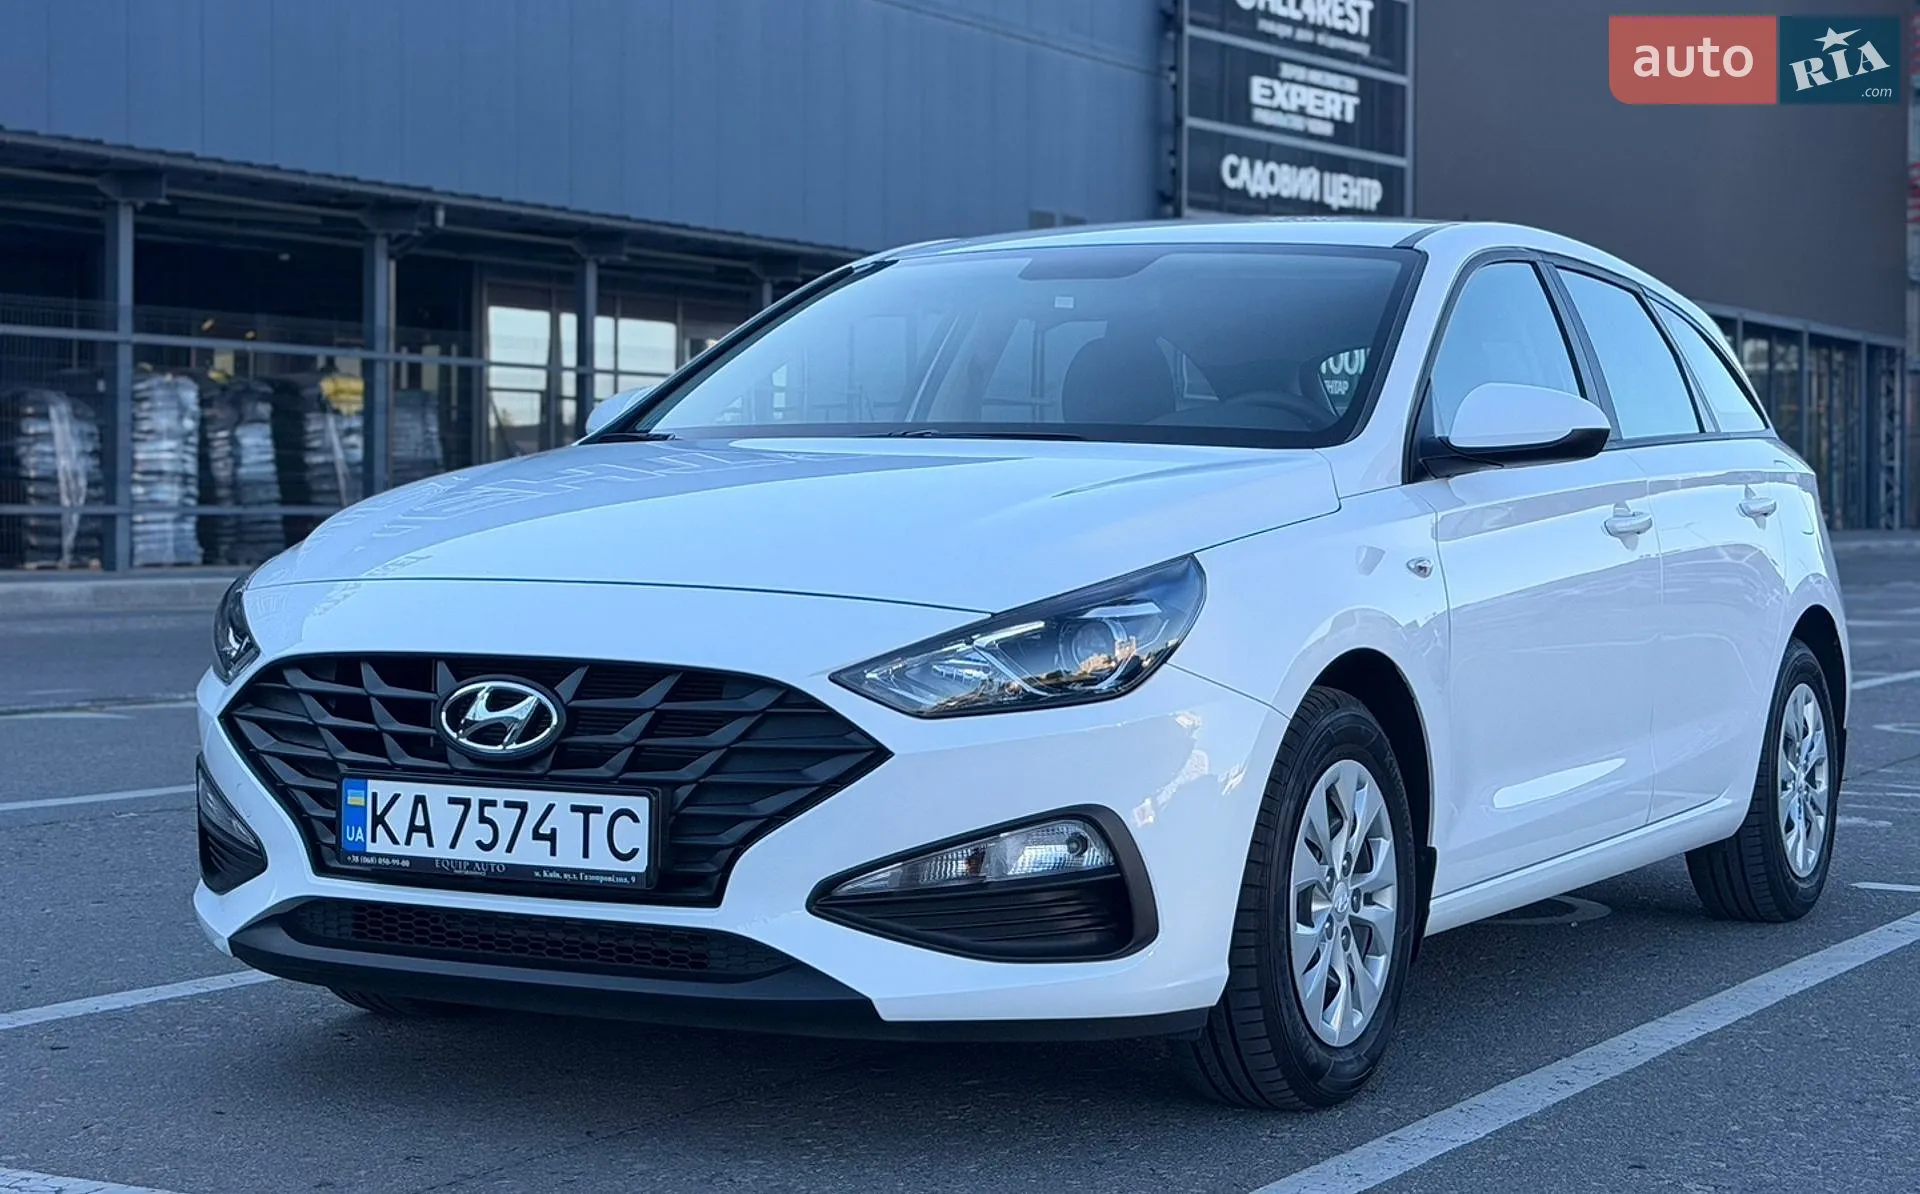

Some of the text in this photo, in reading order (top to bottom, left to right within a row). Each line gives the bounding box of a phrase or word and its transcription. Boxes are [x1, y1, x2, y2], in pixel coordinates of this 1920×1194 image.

[1250, 75, 1360, 123] EXPERT
[1221, 153, 1383, 211] САДОВИЙ ЦЕНТР
[346, 825, 365, 843] UA
[370, 791, 641, 862] KA 7574 TC
[434, 859, 470, 871] EQUIP
[474, 862, 506, 873] AUTO
